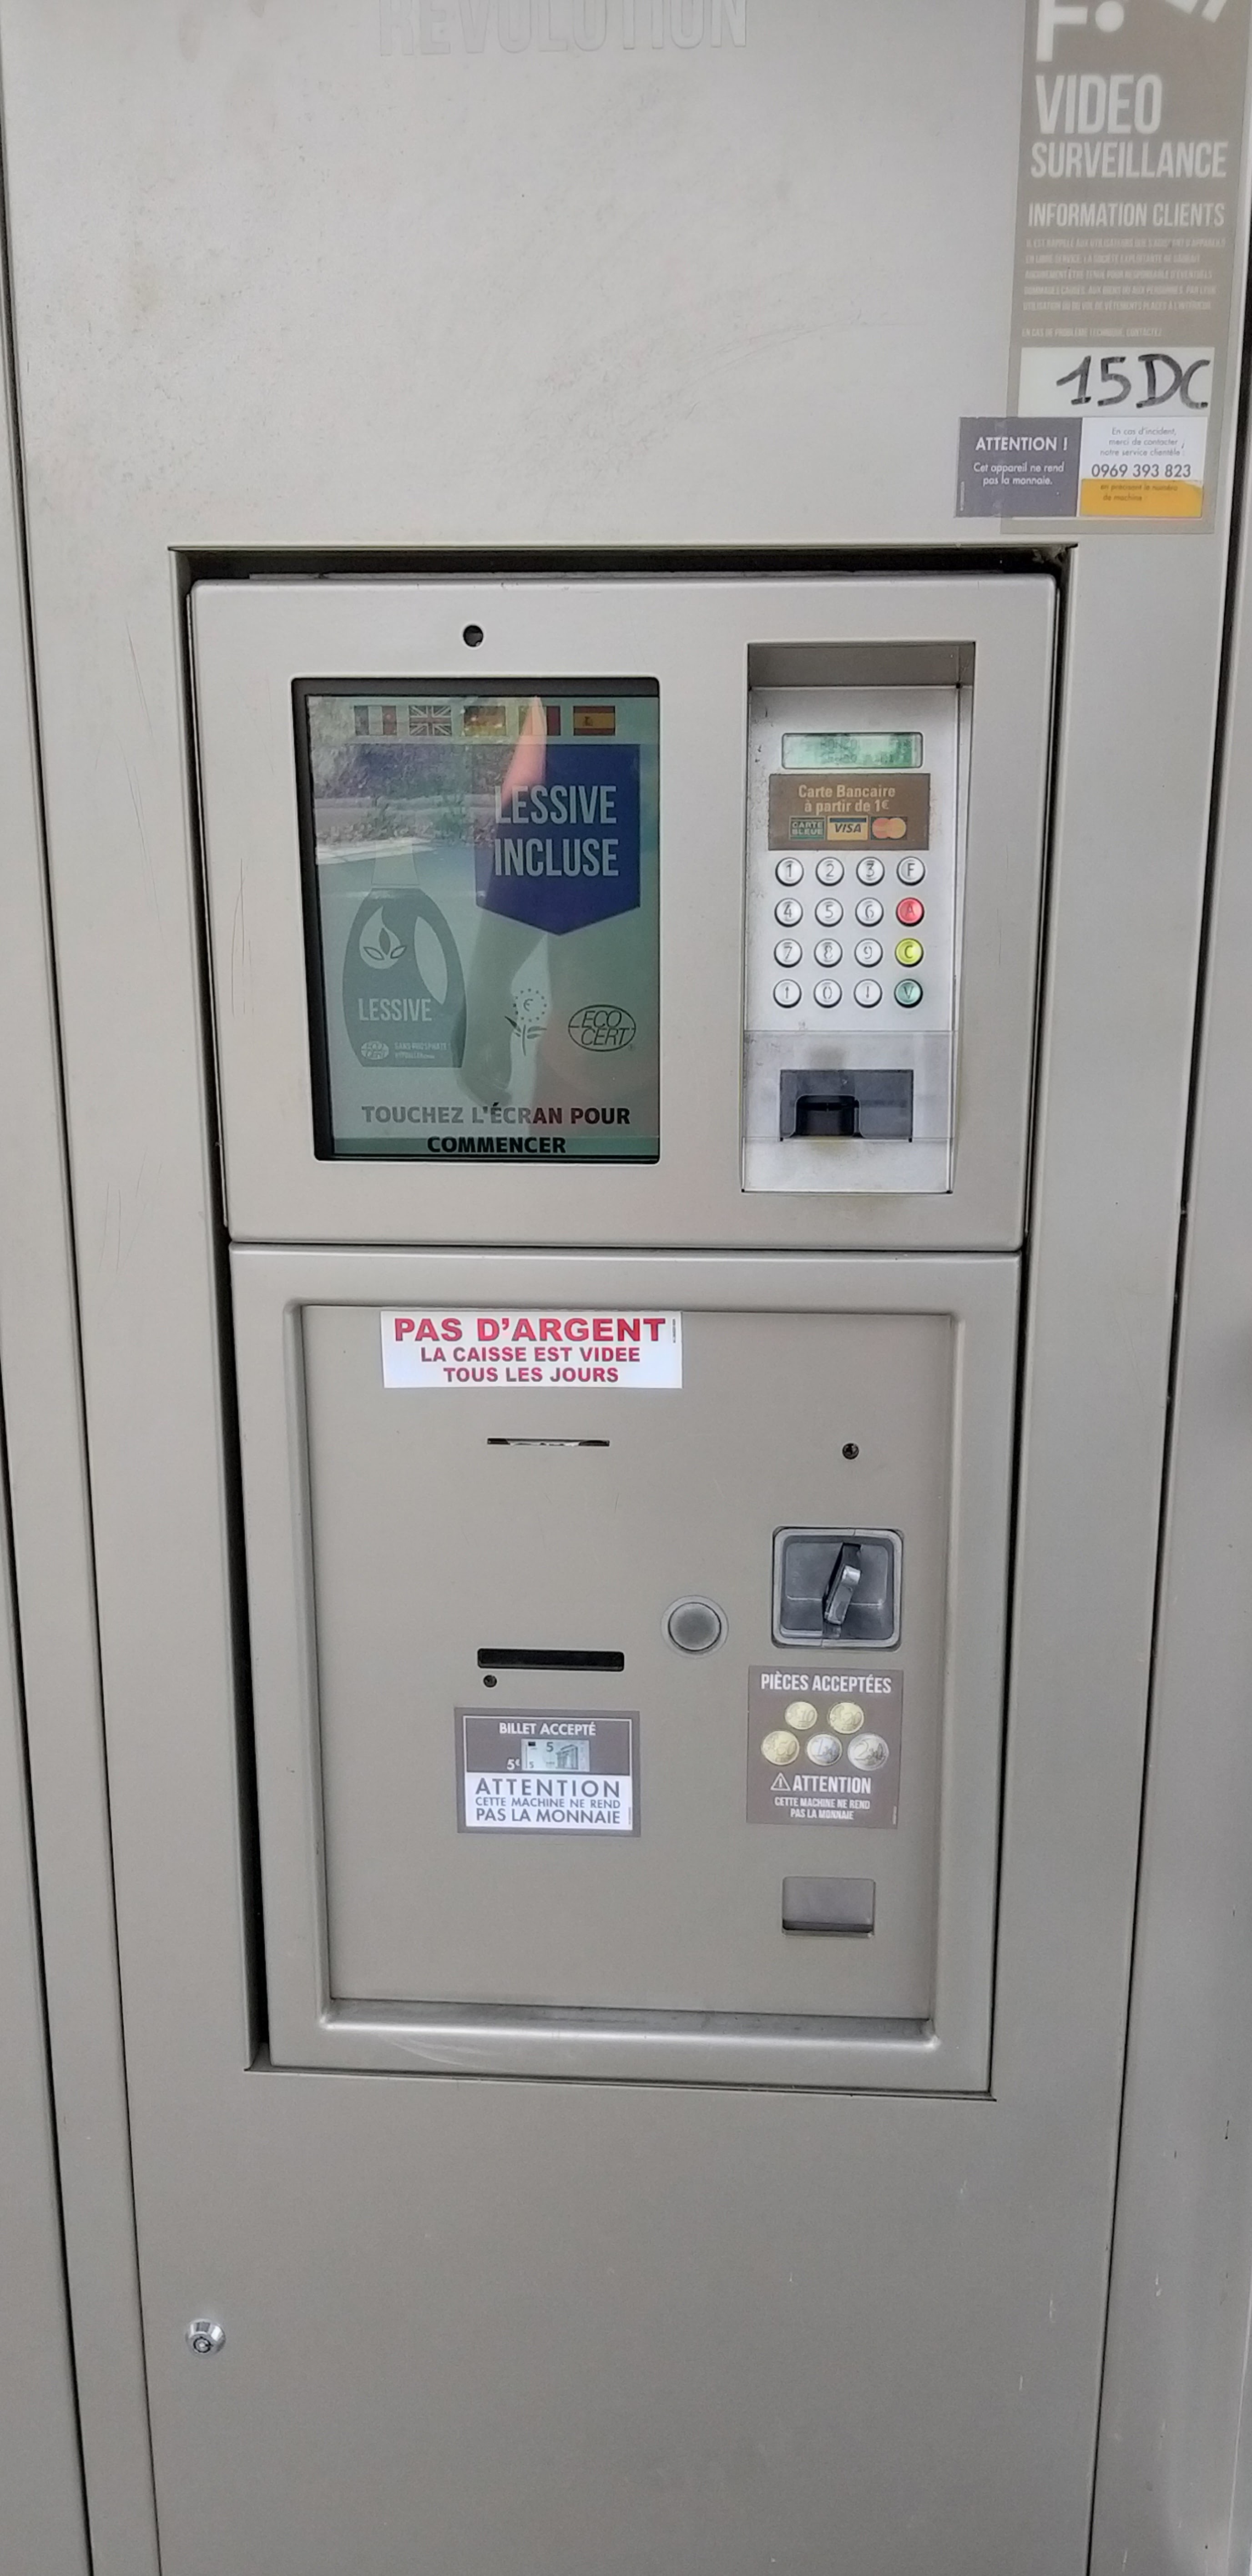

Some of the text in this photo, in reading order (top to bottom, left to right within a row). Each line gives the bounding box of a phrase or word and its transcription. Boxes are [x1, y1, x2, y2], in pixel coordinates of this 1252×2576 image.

[1035, 74, 1162, 135] VIDEO
[1030, 141, 1228, 178] SURVEILLANCE
[1028, 202, 1224, 227] INFORMATION CLIENTS
[1138, 427, 1176, 436] d'incident,
[975, 437, 1057, 451] ATTENTION
[974, 462, 988, 472] Cet
[991, 462, 1027, 474] appareil
[1044, 462, 1064, 472] rend
[1091, 464, 1191, 478] 0969 393 823
[983, 474, 1052, 487] pas la monnaie.
[798, 785, 895, 798] Carte Bancaire
[495, 785, 616, 825] LESSIVE
[804, 799, 889, 815] à partir de 1€
[833, 823, 862, 834] VISA
[495, 839, 619, 876] INCLUSE
[787, 862, 915, 877] 1 2 3 F
[784, 904, 915, 919] 4 5 6 A
[784, 945, 913, 960] 7 8 9 C
[823, 986, 914, 1000] 0 V
[358, 998, 432, 1022] LESSIVE
[583, 1013, 622, 1028] ECO
[581, 1029, 629, 1046] CERT
[362, 1102, 630, 1124] TOUCHEZ L'ÉCRAN POUR
[428, 1136, 566, 1153] COMMENCER
[394, 1318, 463, 1342] PAS
[478, 1318, 666, 1342] D'ARGENT
[421, 1347, 640, 1362] LA CAISSE EST VIDEE
[443, 1367, 619, 1383] TOUS LES JOURS
[761, 1670, 892, 1693] PIÈCES ACCEPTÉES
[499, 1721, 596, 1736] BILLET ACCEPTÉ
[546, 1742, 554, 1752] 5
[475, 1778, 620, 1798] ATTENTION
[793, 1775, 871, 1794] ATTENTION
[475, 1797, 621, 1809] CETTE MACHINE NE REND
[775, 1797, 870, 1810] CETTE MACHINE NE REND
[476, 1808, 506, 1821] PAS
[512, 1809, 530, 1822] LA
[536, 1809, 620, 1824] MONNAIE
[791, 1809, 805, 1818] PAS
[819, 1810, 854, 1820] MONNAIE
